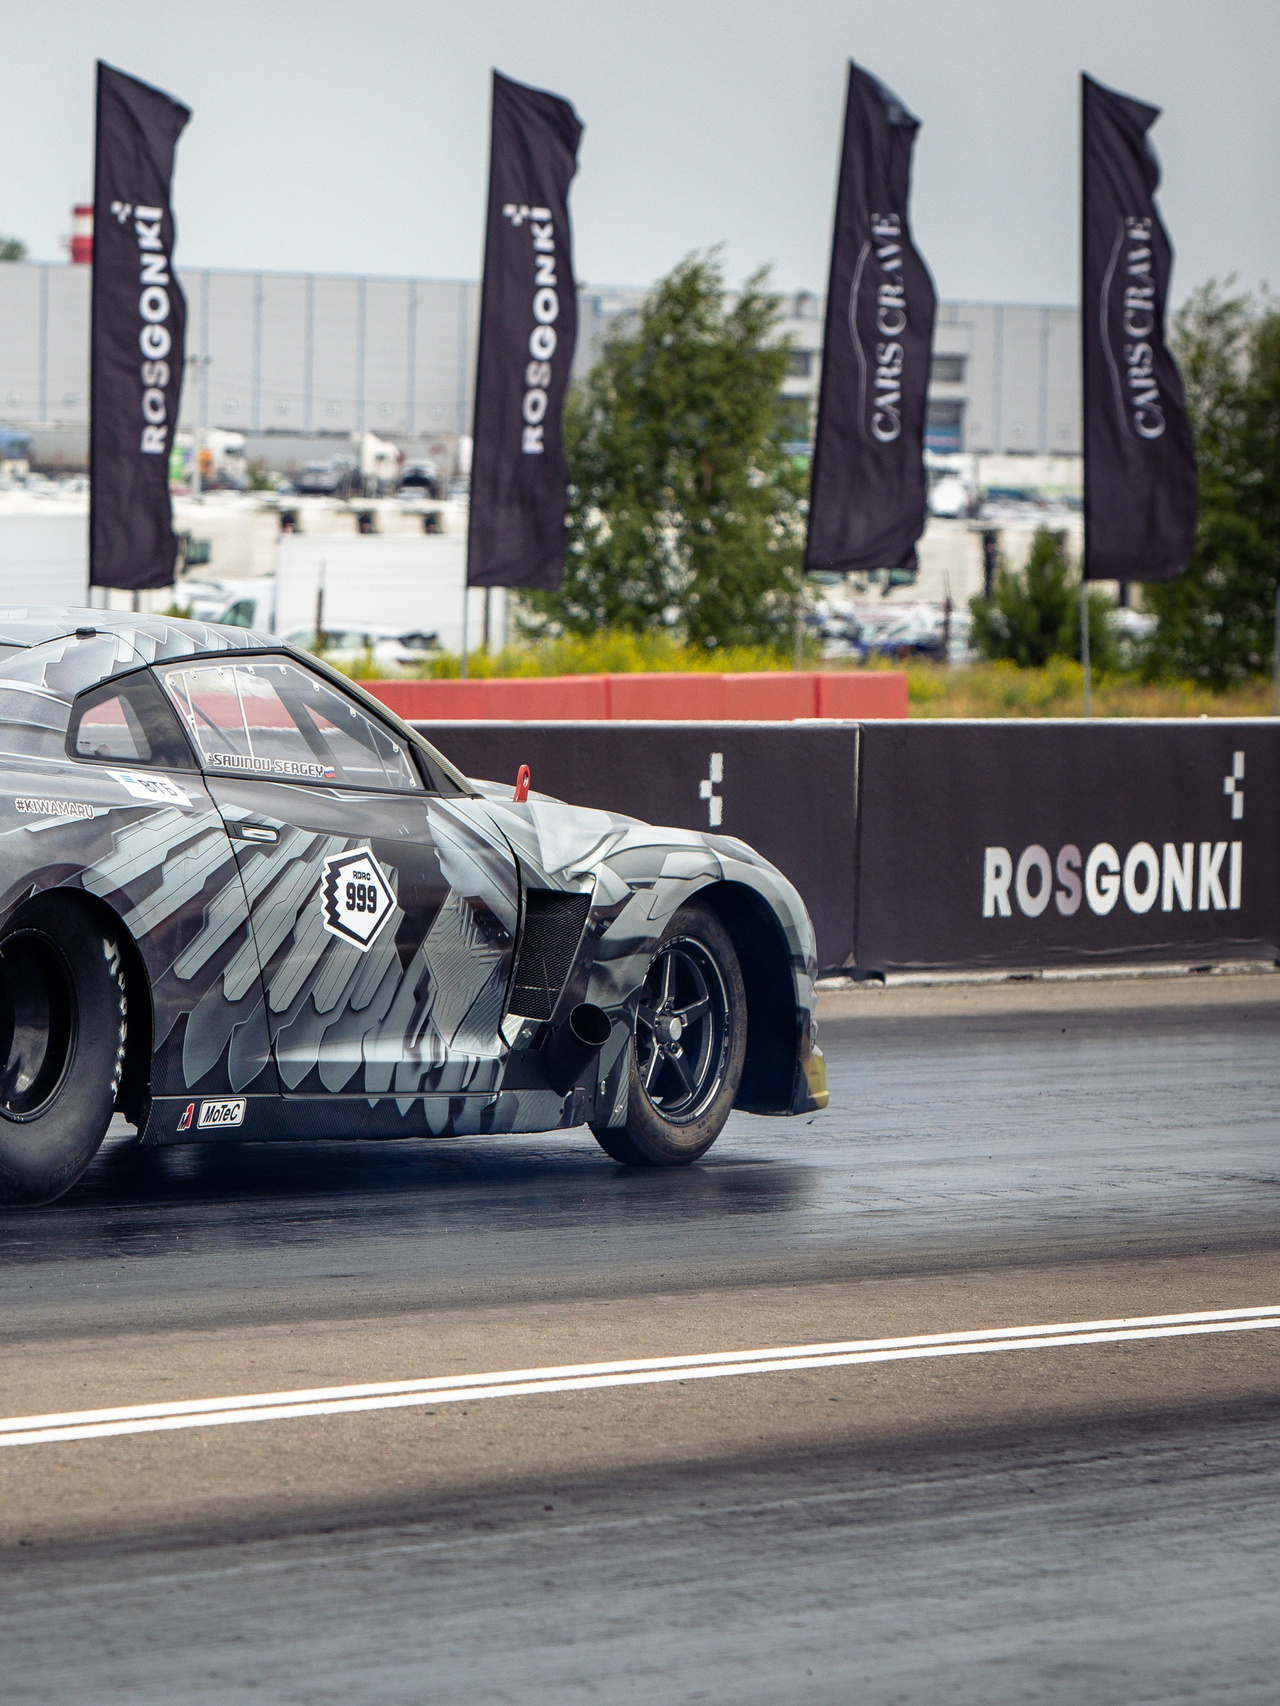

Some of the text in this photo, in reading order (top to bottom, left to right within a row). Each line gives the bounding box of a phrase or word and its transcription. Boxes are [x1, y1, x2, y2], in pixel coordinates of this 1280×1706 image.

[135, 205, 170, 455] ROSGONKI
[521, 206, 560, 455] ROSGONKI
[872, 212, 906, 442] CARS CRAVE
[1123, 215, 1166, 440] CARS CRAVE
[273, 760, 325, 778] SERGEY
[16, 798, 94, 819] #KIWAMARU
[346, 882, 377, 914] 999
[982, 841, 1243, 918] ROSGONKI
[202, 1103, 241, 1124] MoTeC
